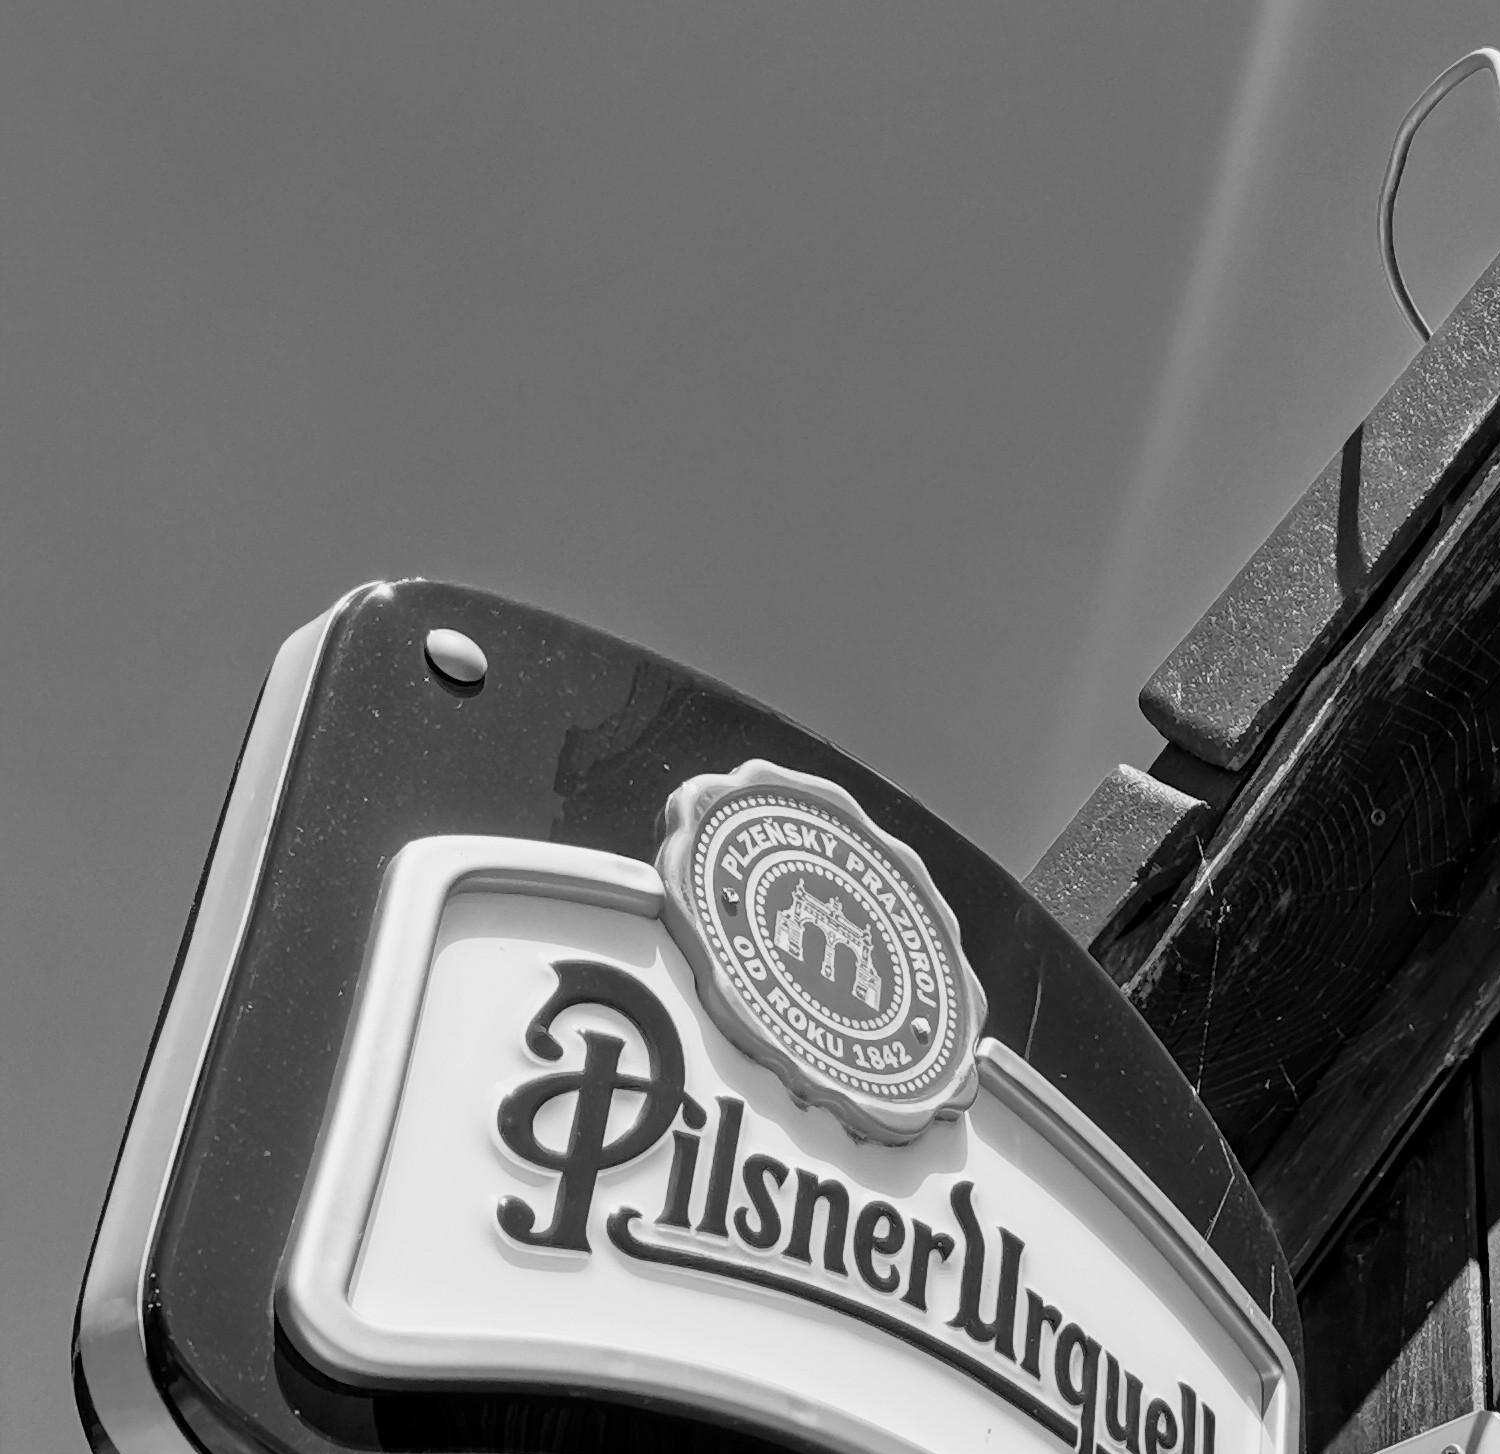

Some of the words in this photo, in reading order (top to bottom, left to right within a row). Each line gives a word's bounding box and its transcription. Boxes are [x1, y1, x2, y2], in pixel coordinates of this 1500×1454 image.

[721, 817, 838, 881] PLZEŇSKÝ
[846, 851, 937, 1008] PRAZDROJ
[733, 935, 767, 981] OD
[766, 986, 844, 1058] ROKU
[852, 1041, 913, 1071] 1842
[496, 958, 957, 1311] Pilsner
